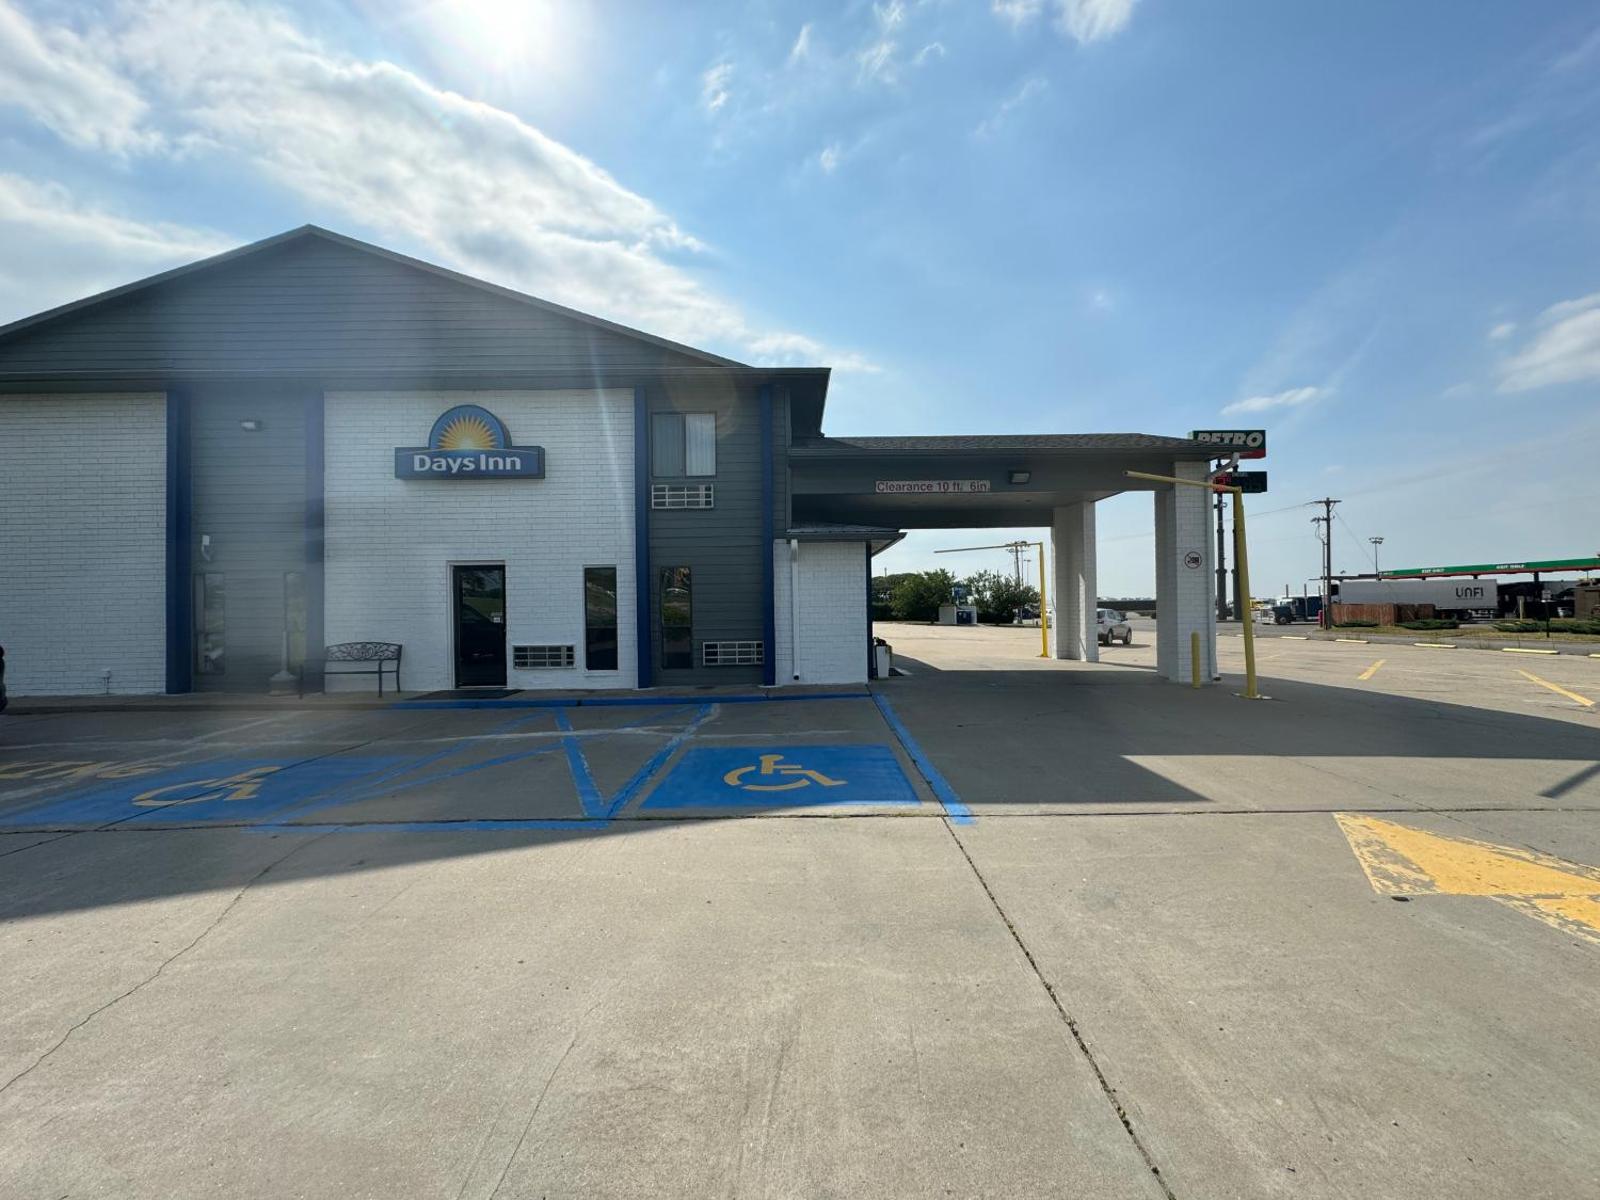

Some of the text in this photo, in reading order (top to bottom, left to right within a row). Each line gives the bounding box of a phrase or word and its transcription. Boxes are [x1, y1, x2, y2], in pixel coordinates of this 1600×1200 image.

[1197, 432, 1264, 448] PETRO
[413, 454, 521, 473] Days Inn
[877, 481, 933, 492] Clearance
[938, 481, 949, 491] 10
[1455, 586, 1484, 598] UNFI
